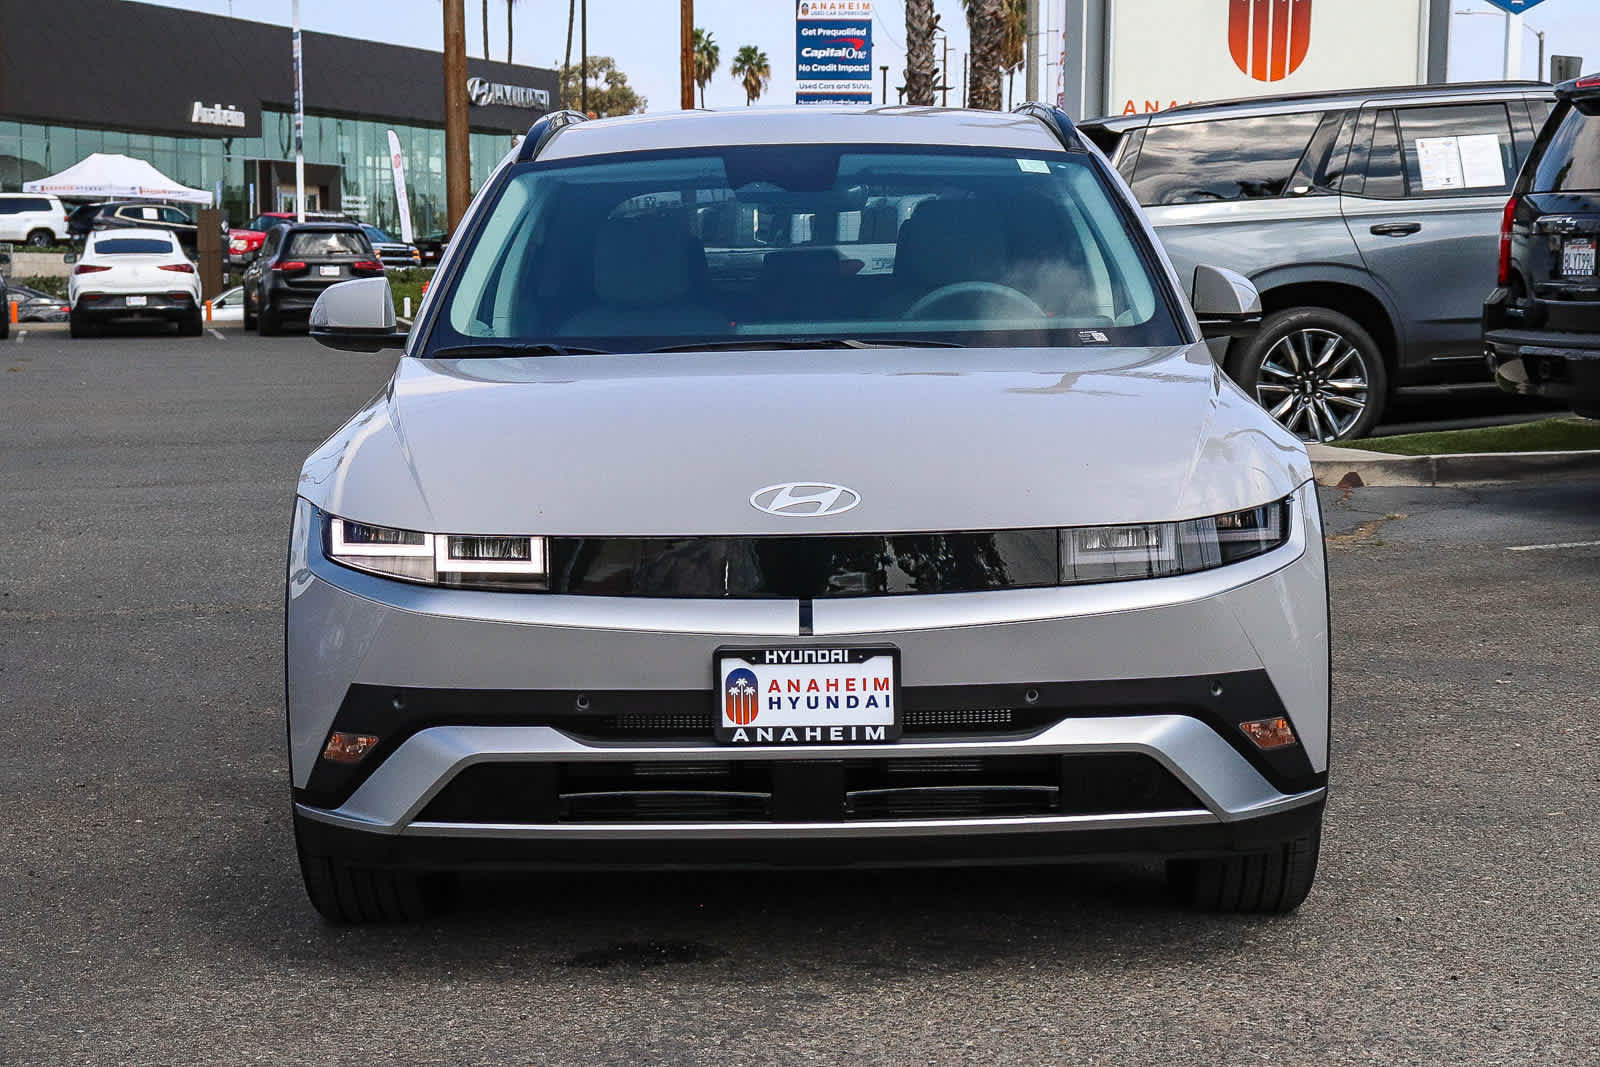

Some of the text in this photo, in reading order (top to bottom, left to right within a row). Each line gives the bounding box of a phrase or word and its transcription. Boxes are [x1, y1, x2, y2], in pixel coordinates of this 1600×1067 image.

[811, 2, 871, 10] ANAHEIM
[801, 28, 866, 37] Get Prequalified
[798, 64, 870, 73] No Credit Impact!
[765, 649, 849, 664] HYUNDAI
[767, 677, 891, 693] ANAHEIM
[768, 694, 891, 710] HYUNDAI
[732, 726, 886, 742] ANAHEIM
